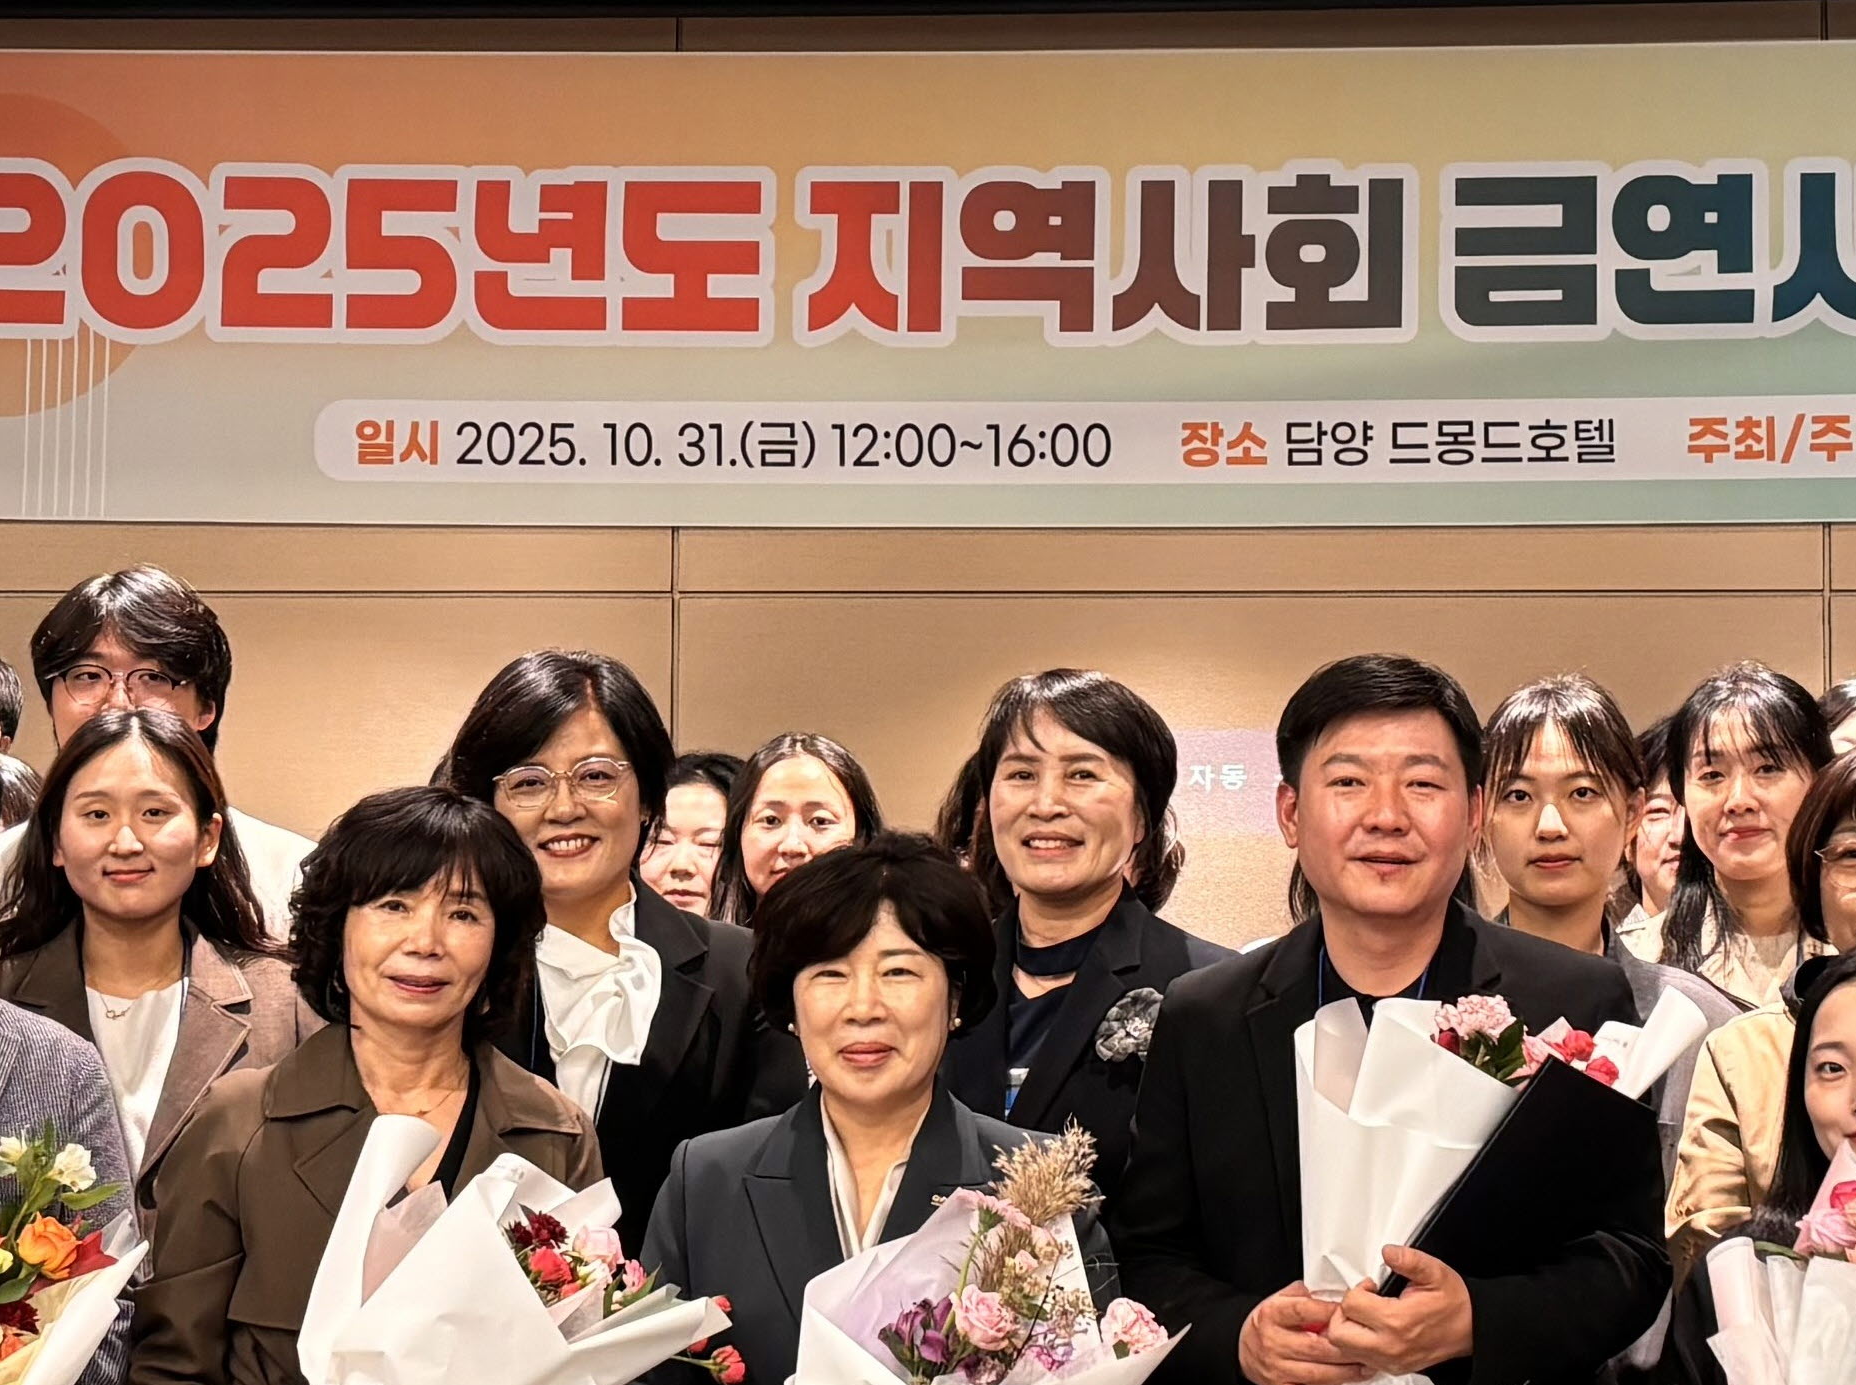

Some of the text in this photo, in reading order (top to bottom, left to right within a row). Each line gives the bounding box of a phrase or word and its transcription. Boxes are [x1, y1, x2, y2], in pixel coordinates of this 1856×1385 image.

[807, 173, 1404, 332] 지역사회
[355, 420, 439, 465] 일시
[456, 421, 586, 467] 2025.
[603, 422, 662, 467] 10.
[678, 420, 816, 468] 31.(금)
[831, 422, 1111, 467] 12:00~16:00
[1181, 421, 1268, 467] 장소
[1286, 420, 1374, 466] 담양
[1389, 418, 1616, 466] 드몽드호텔
[1188, 763, 1247, 791] 자동
